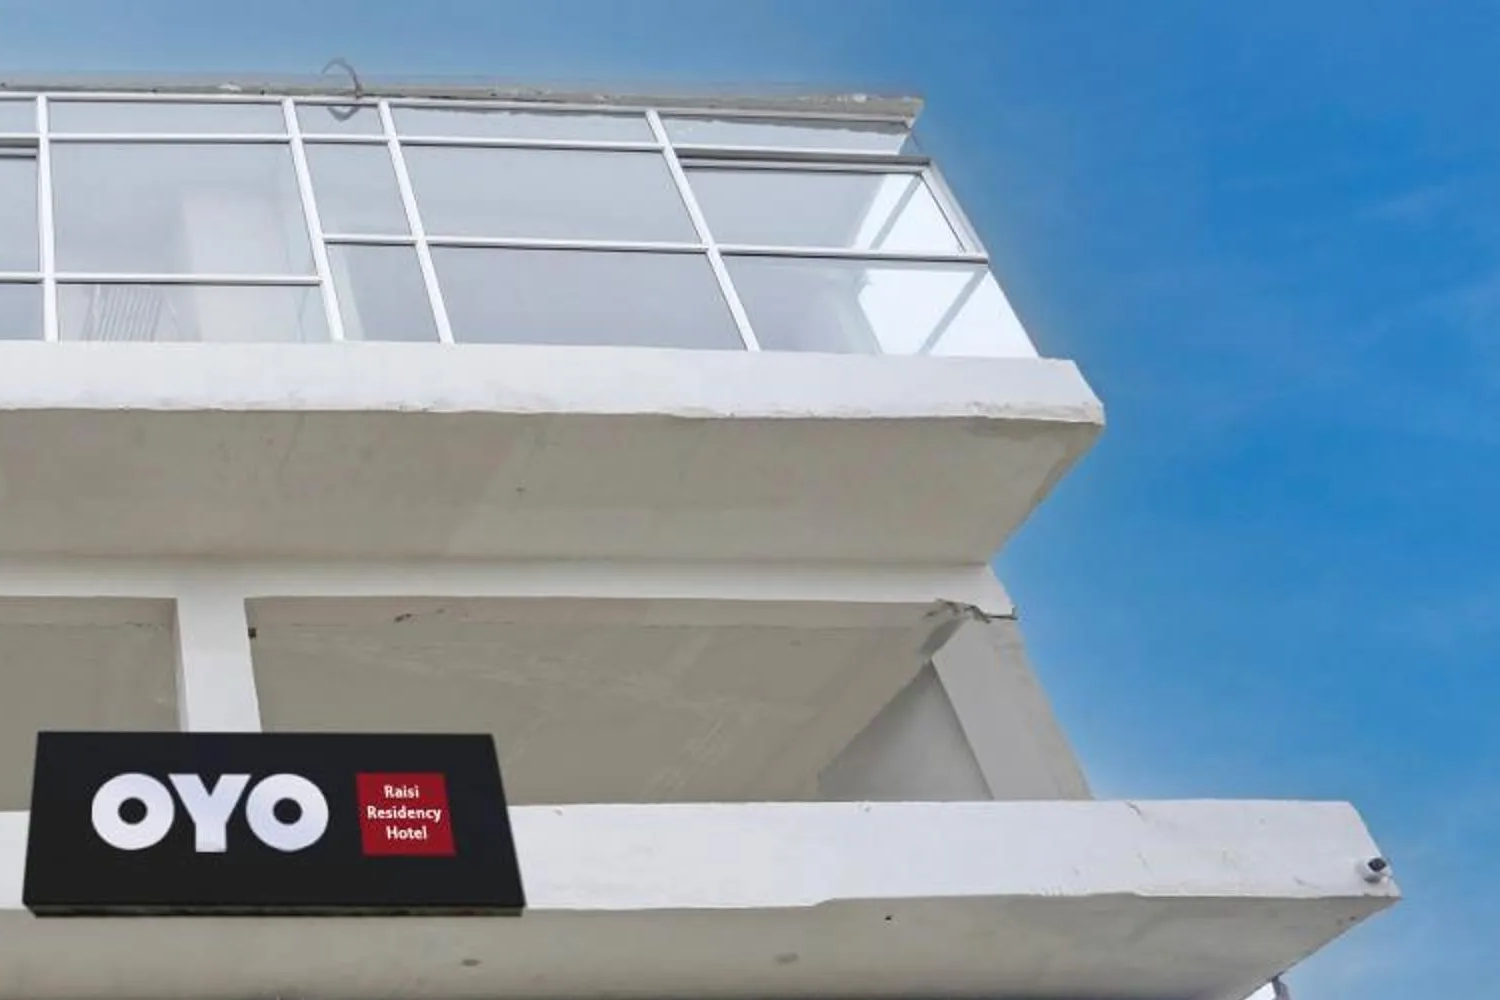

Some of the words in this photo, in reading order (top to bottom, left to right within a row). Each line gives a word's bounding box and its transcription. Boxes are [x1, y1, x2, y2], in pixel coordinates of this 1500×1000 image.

[384, 785, 419, 799] Raisi
[91, 772, 329, 853] OYO
[367, 805, 442, 824] Residency
[386, 825, 428, 841] Hotel
